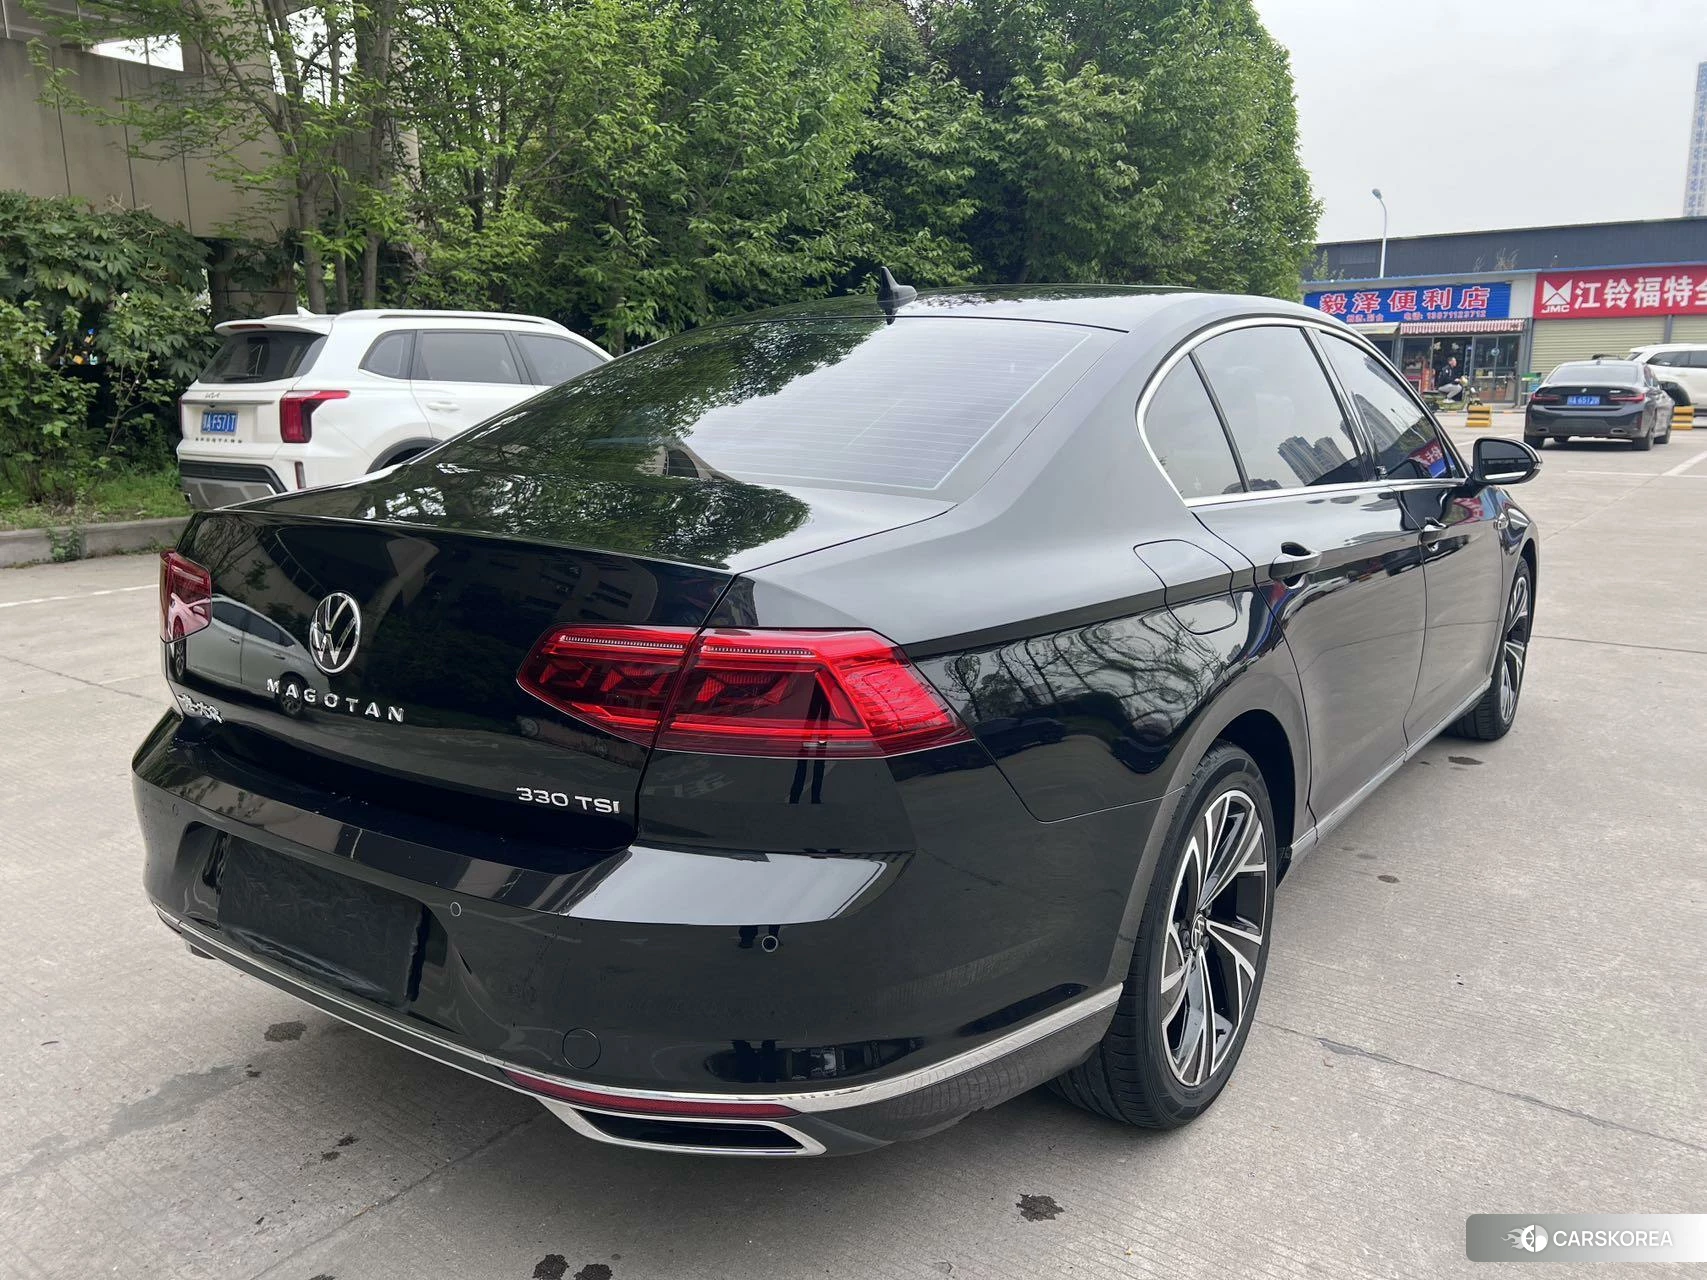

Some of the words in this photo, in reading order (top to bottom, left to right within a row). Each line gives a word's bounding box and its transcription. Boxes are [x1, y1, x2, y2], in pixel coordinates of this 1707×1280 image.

[1319, 286, 1491, 315] 毅泽便利店
[1541, 304, 1570, 314] JMC
[266, 678, 405, 723] MAGOTAN
[516, 787, 569, 807] 330
[574, 795, 620, 814] TSI
